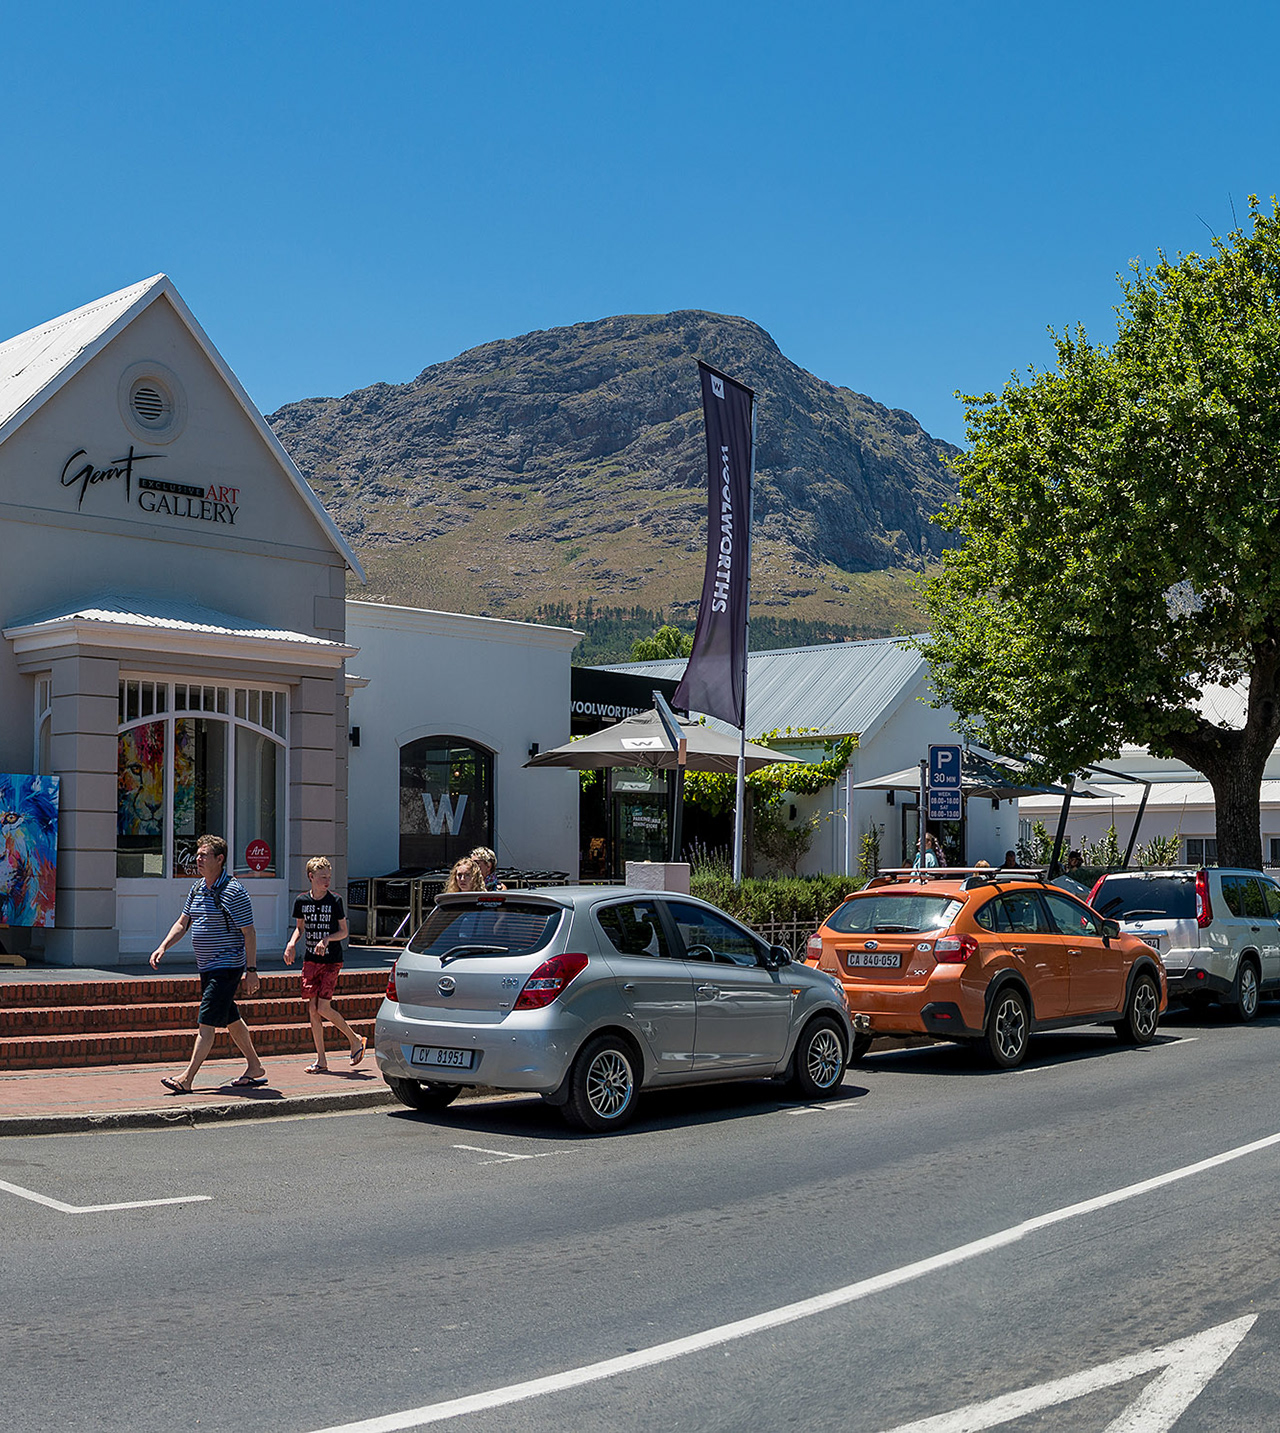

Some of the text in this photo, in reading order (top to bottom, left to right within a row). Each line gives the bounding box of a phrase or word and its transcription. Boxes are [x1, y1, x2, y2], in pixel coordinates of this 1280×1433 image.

[141, 479, 203, 496] EXCLUSIVE
[204, 484, 241, 504] ART
[138, 490, 240, 525] GALLERY
[711, 445, 733, 614] WOOLWORTHS
[937, 751, 953, 769] P
[933, 772, 946, 783] 30
[421, 793, 469, 836] W
[251, 846, 265, 856] Art
[255, 863, 261, 871] 6
[321, 905, 332, 913] USA
[849, 954, 898, 967] CA 840-052
[419, 1048, 464, 1065] CY 81951
